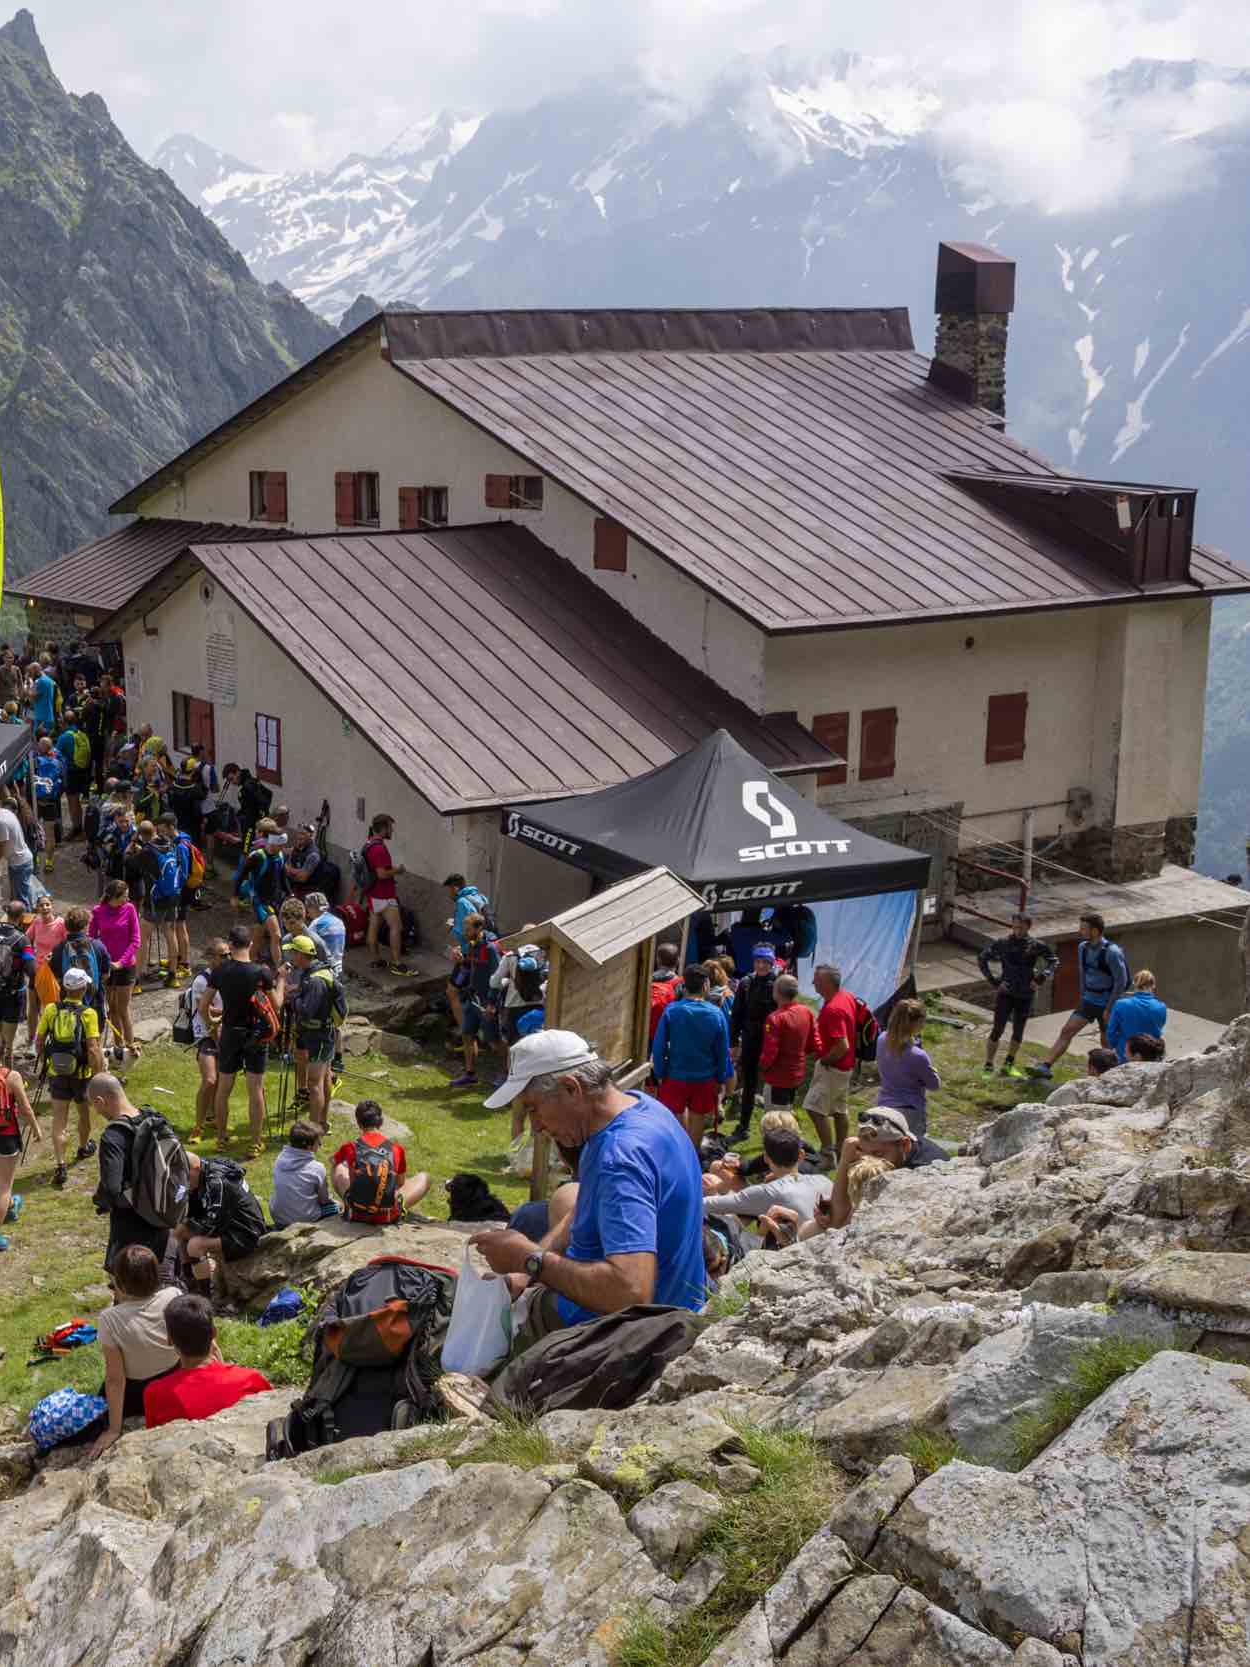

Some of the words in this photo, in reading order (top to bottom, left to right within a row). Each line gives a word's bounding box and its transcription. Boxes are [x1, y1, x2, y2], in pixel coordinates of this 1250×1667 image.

[519, 824, 582, 855] SCOTT
[738, 839, 851, 862] SCOTT
[719, 881, 803, 902] SCOTT
